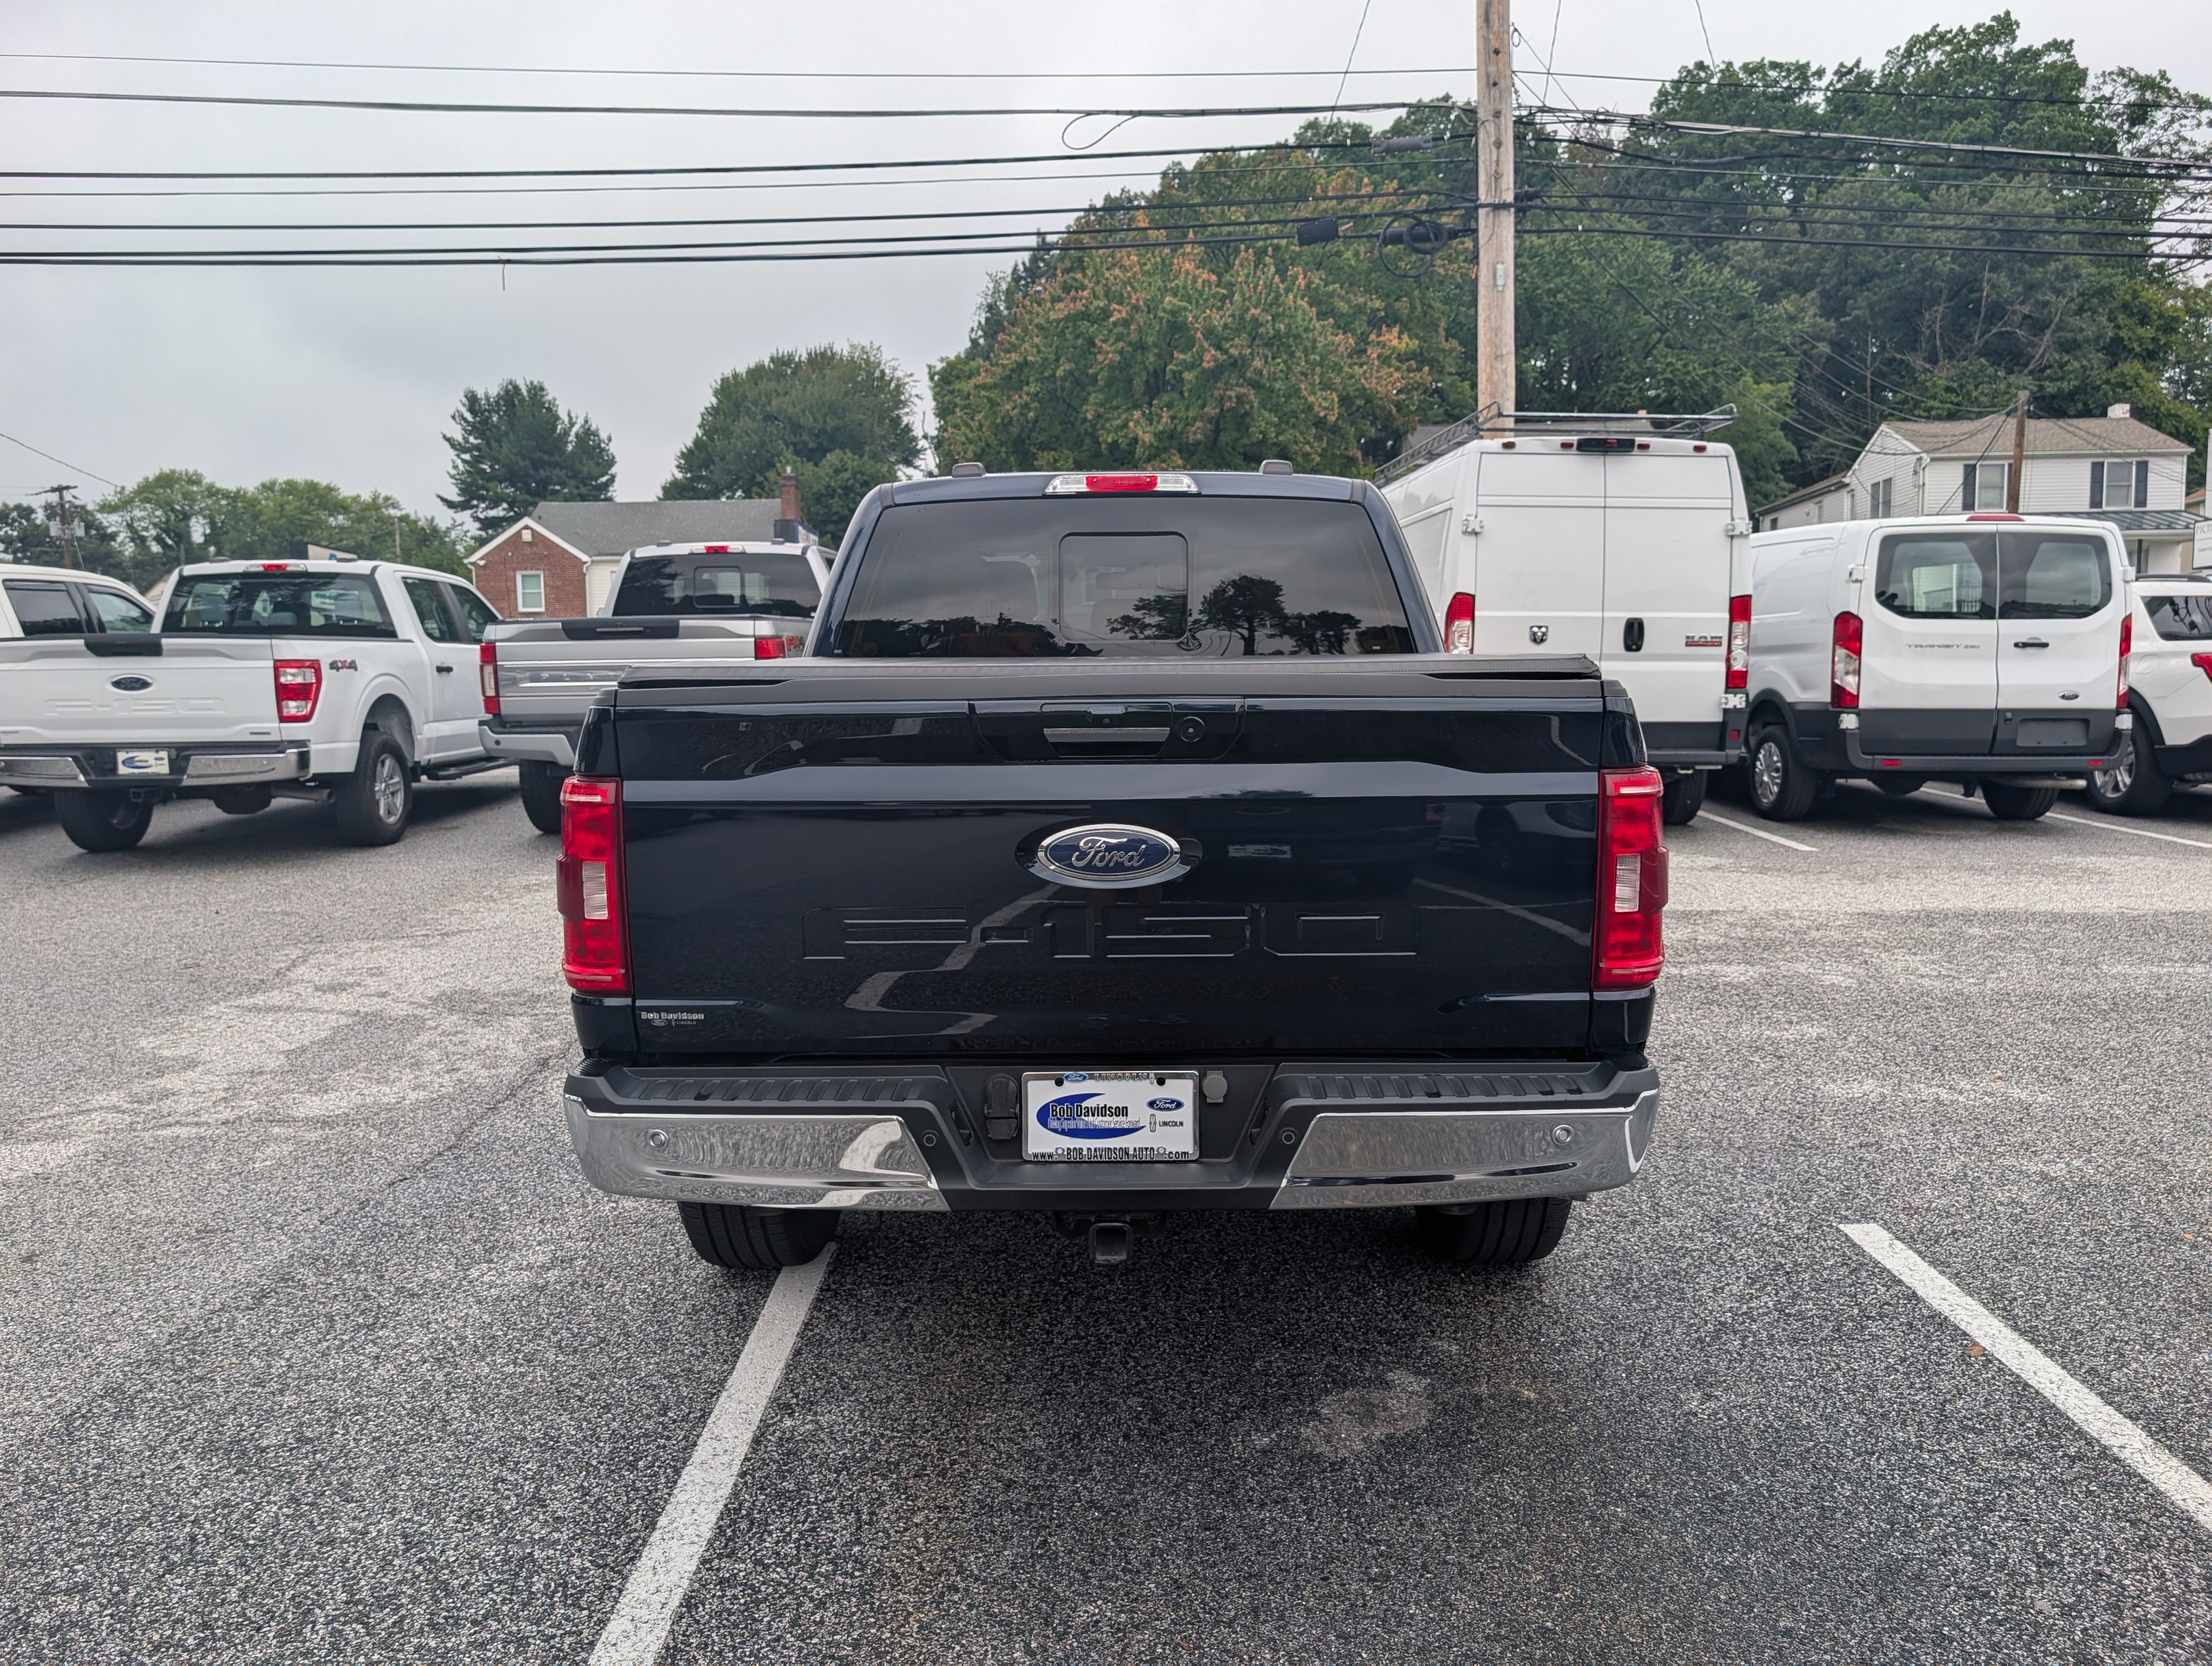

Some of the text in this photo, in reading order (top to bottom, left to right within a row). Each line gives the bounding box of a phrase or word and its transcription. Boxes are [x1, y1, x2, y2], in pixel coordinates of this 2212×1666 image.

[1072, 837, 1147, 867] Ford
[801, 902, 1419, 959] F-150
[1154, 1099, 1177, 1108] Ford
[1051, 1104, 1129, 1117] Bob Davidson
[1112, 1118, 1126, 1128] Service
[1066, 1147, 1083, 1160] BOB
[1086, 1147, 1130, 1160] DAVIDSON
[1132, 1146, 1155, 1160] AUTO
[1163, 1151, 1189, 1160] .com
